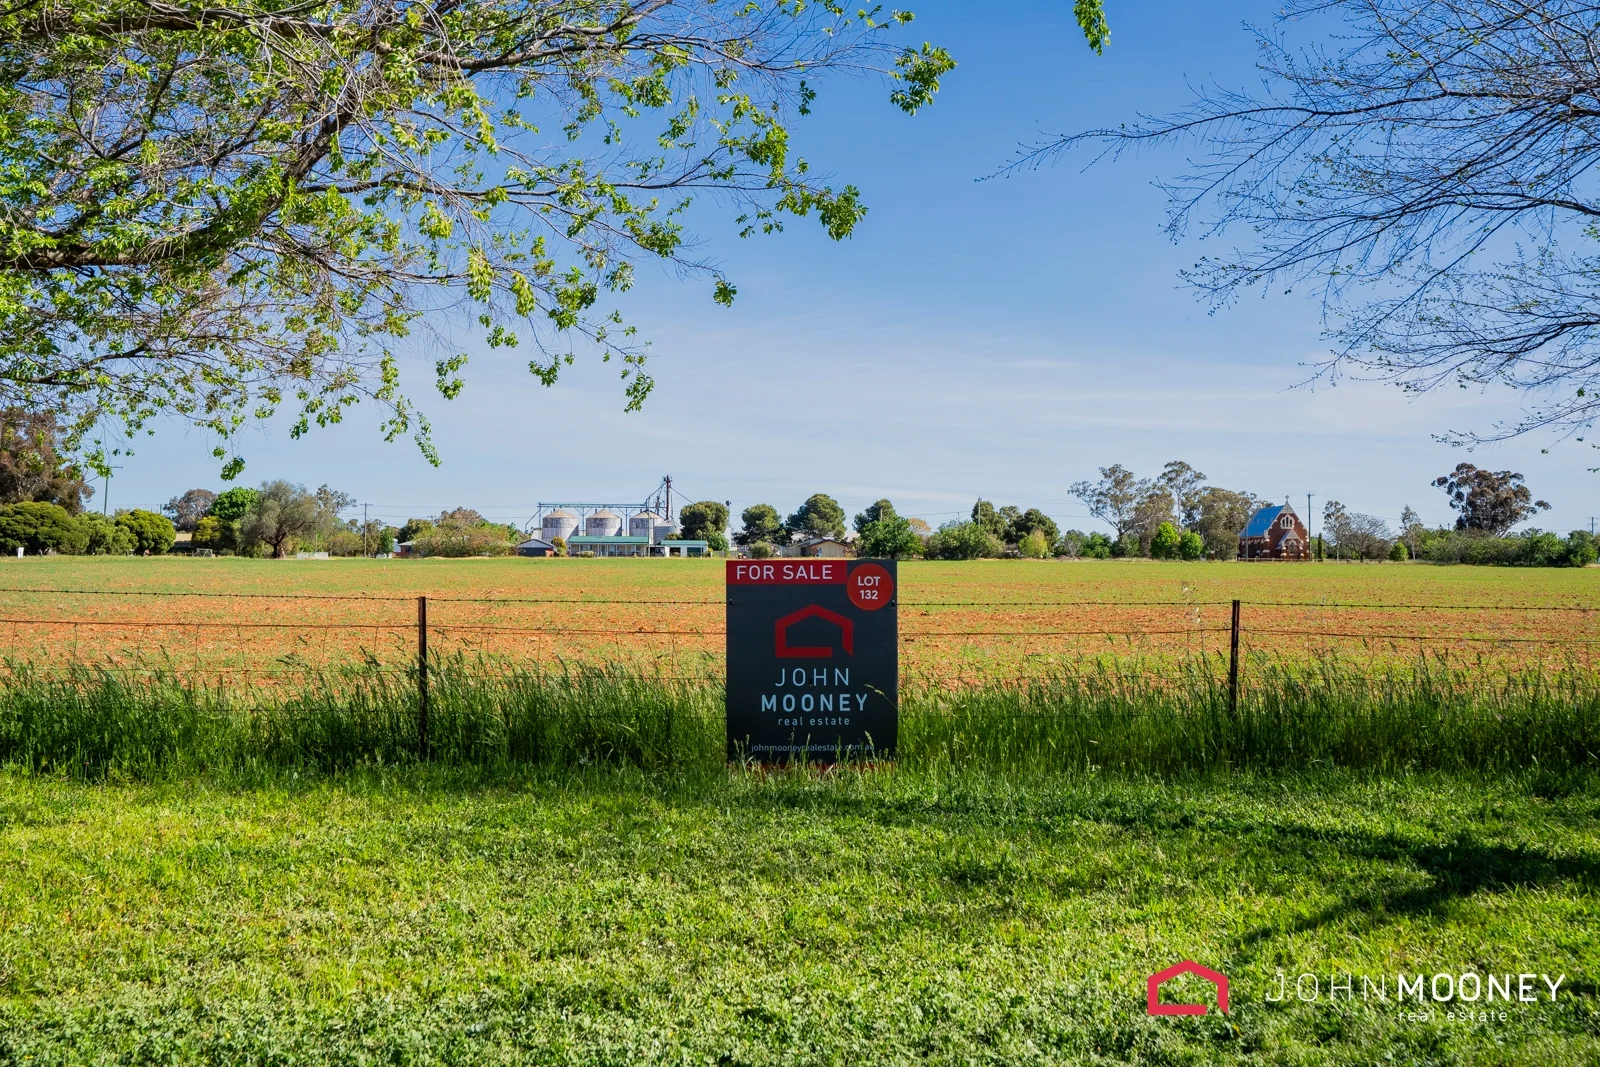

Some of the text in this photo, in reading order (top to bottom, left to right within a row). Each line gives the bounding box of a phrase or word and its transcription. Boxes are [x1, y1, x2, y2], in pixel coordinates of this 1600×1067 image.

[736, 565, 833, 580] FOR SALE
[857, 576, 881, 587] LOT
[860, 590, 879, 600] 132
[775, 668, 850, 687] JOHN
[761, 693, 868, 712] MOONEY
[777, 716, 850, 726] real estate
